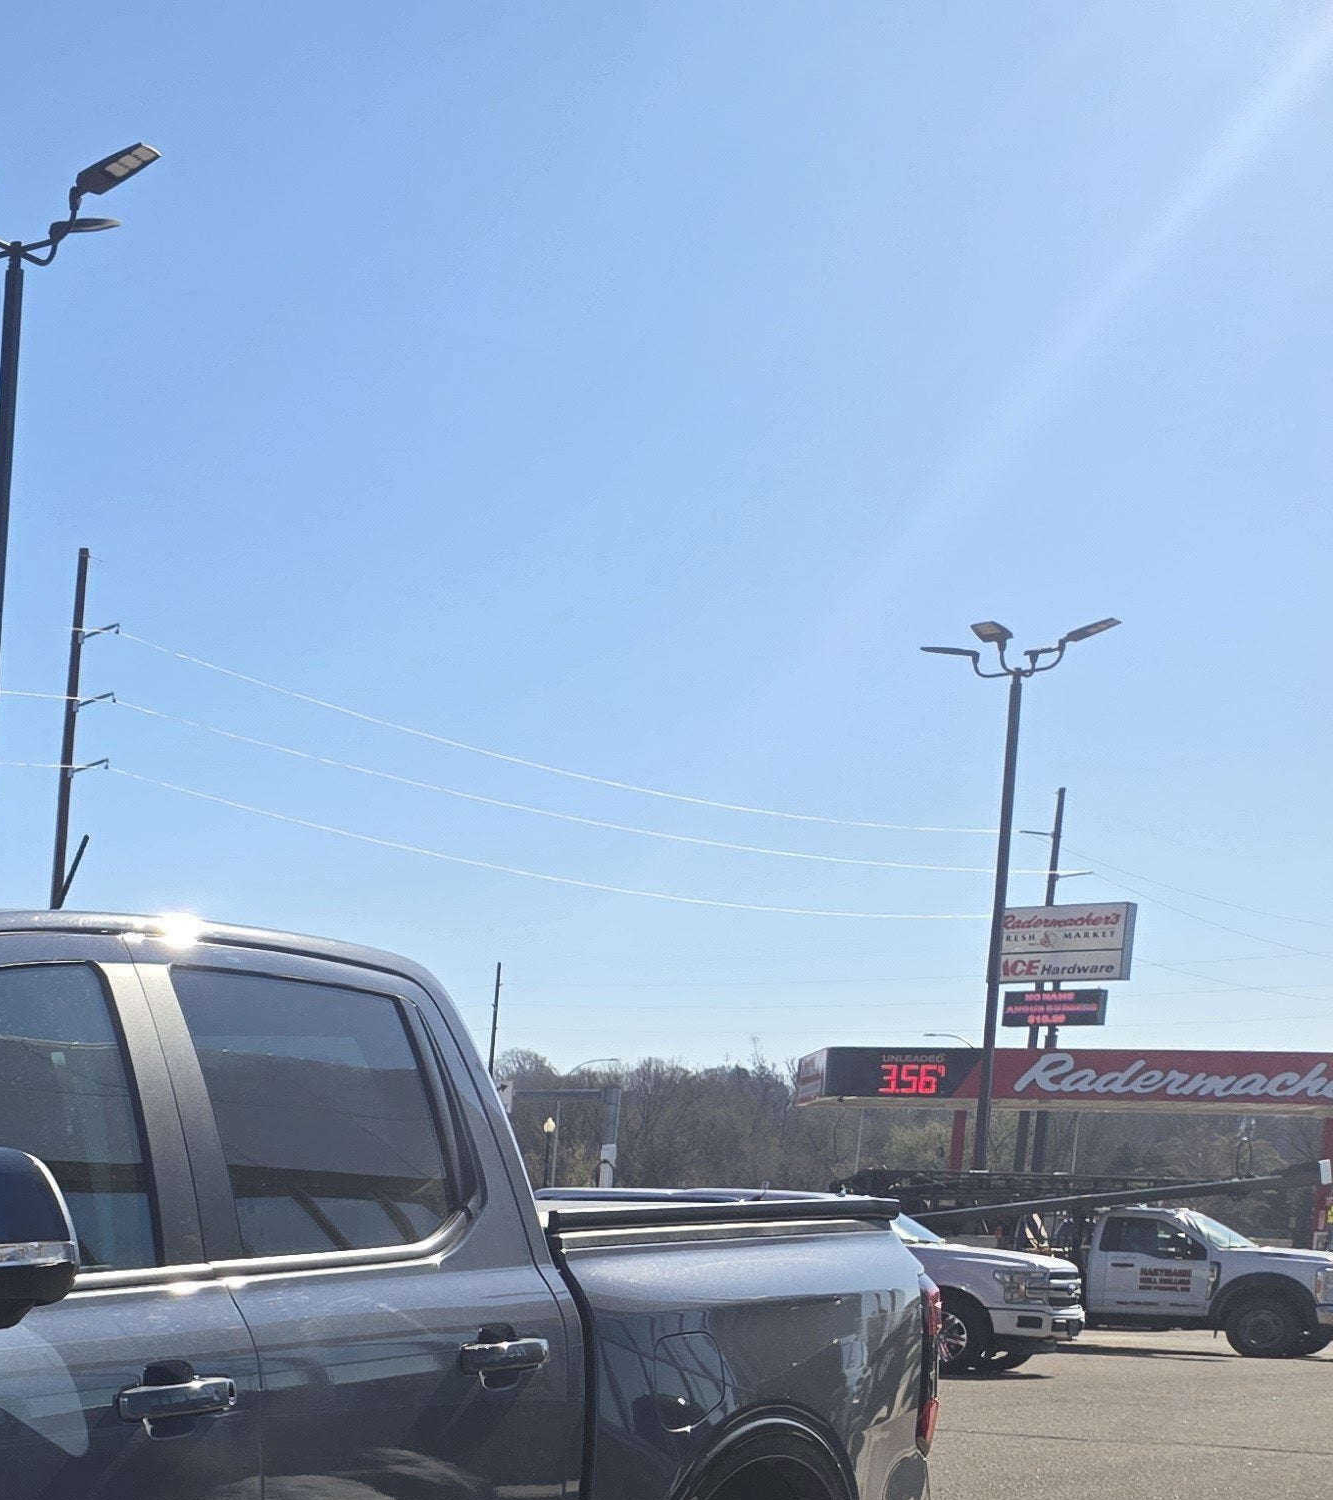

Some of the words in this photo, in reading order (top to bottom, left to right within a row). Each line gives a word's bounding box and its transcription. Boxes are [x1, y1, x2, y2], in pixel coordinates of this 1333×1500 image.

[1005, 934, 1036, 942] RESH
[1063, 930, 1116, 940] MARKET
[1040, 963, 1115, 977] Hardware
[883, 1053, 945, 1063] UNLEADED
